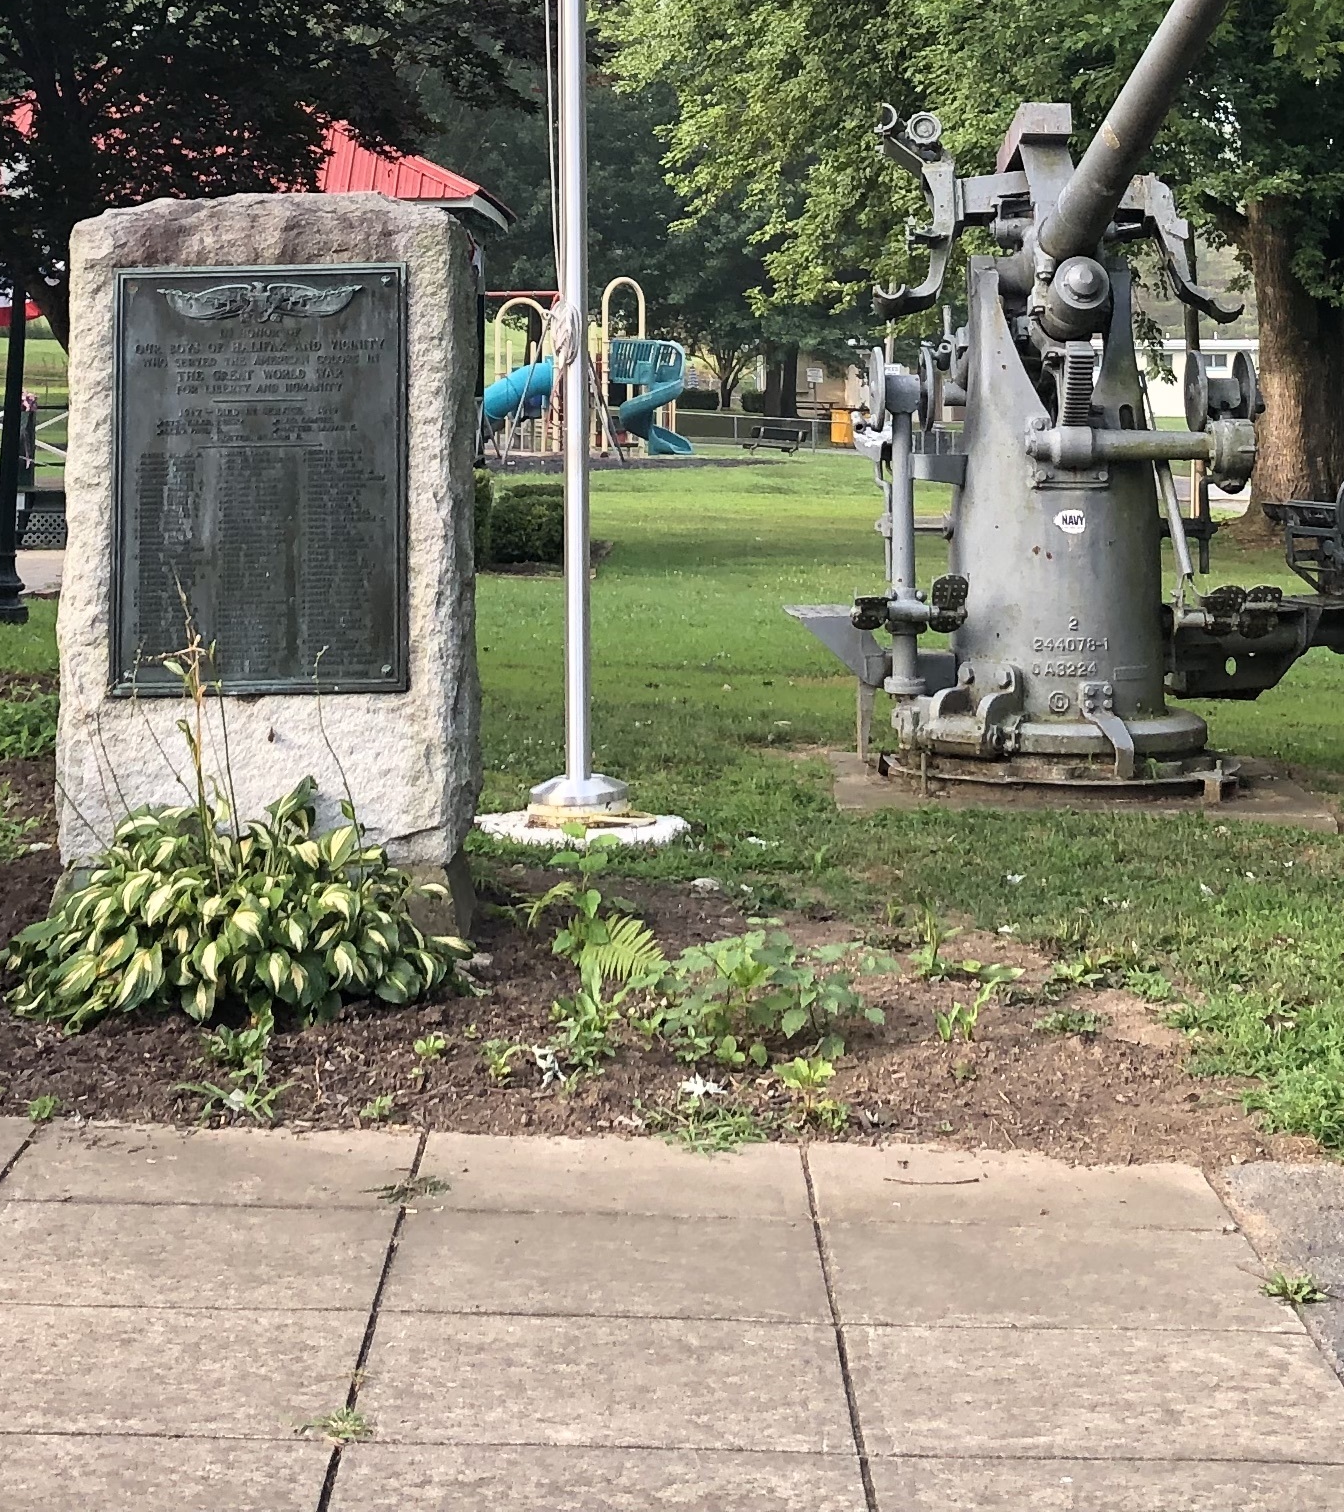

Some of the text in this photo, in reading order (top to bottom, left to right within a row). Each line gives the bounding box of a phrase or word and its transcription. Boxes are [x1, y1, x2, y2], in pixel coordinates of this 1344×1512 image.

[135, 338, 385, 355] OUR BOYS OF HALIFAX AND VICINITY
[143, 353, 381, 368] WHO SERVED THE AMERICAN COLORS IN
[176, 368, 344, 382] THE GREAT WORLD WAR
[176, 381, 343, 395] FOR LIBERTY AND HUMANITY
[1061, 515, 1085, 526] NAVY
[1067, 616, 1079, 632] 2
[1033, 636, 1109, 653] 244078-1
